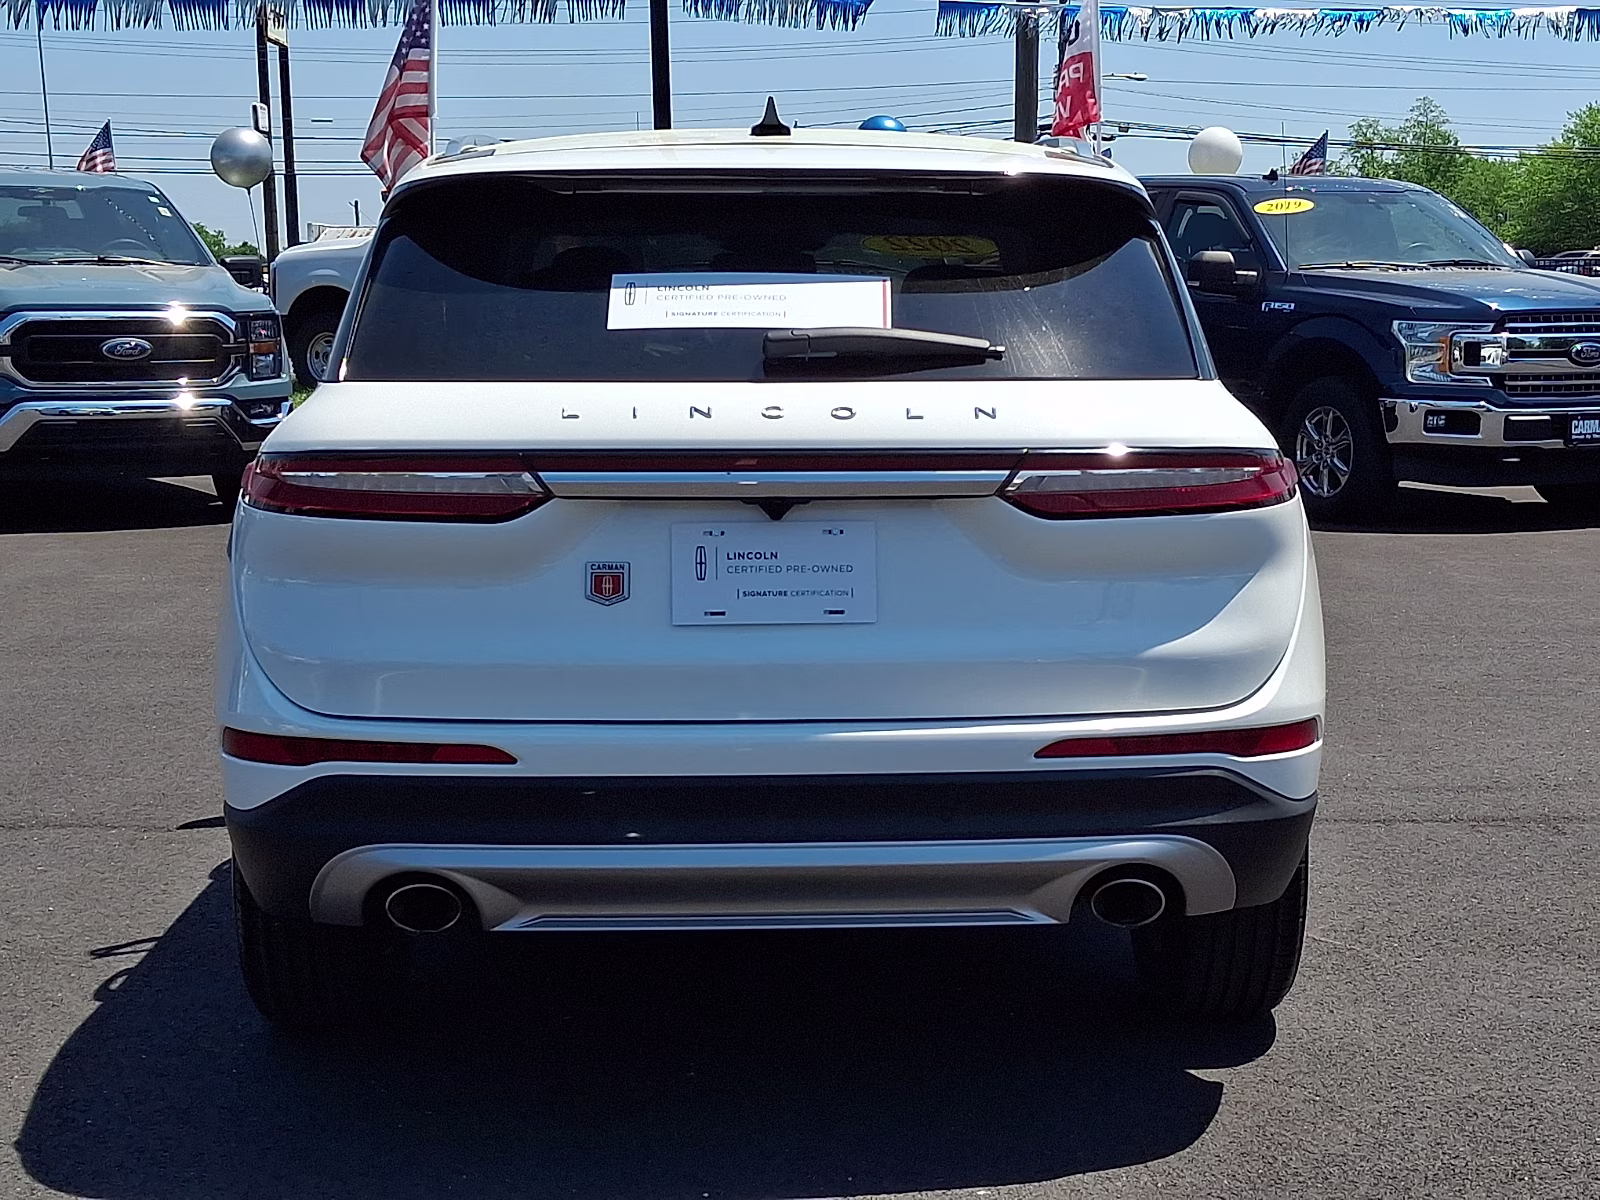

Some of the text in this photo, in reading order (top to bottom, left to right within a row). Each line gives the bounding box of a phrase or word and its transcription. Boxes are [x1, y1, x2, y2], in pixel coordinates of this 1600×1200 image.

[1266, 201, 1302, 212] 2019
[656, 284, 710, 292] LINCOLN
[656, 293, 787, 302] CERTIFIED PRE-OWNED
[114, 342, 142, 356] Ford
[561, 406, 998, 421] LINCOLN
[726, 551, 778, 561] LINCOLN
[590, 563, 625, 571] CARMAN
[726, 564, 854, 574] CERTIFIED PRE-OWNED
[742, 589, 849, 598] SIGNATURE CERTIFICATION
